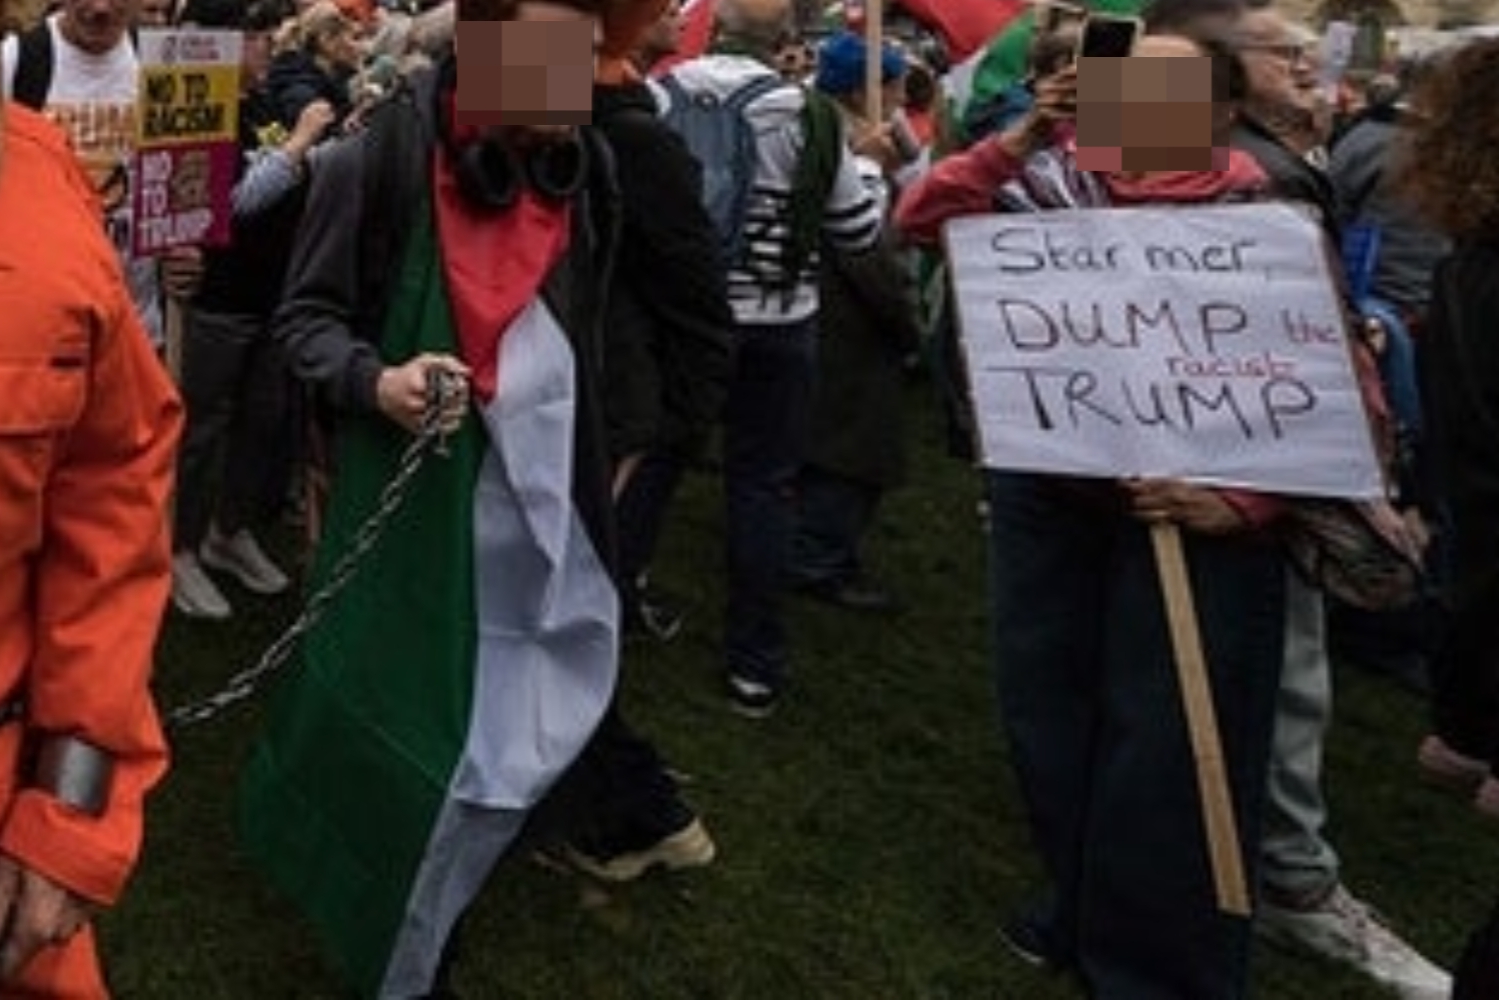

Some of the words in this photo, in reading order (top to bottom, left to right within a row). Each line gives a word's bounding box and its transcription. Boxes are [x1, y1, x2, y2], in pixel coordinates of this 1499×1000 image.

[146, 73, 176, 103] NO
[182, 73, 210, 103] TO
[143, 104, 224, 139] RACISM
[996, 297, 1248, 356] DUMP
[1280, 308, 1339, 344] the
[986, 365, 1319, 440] TRUMP
